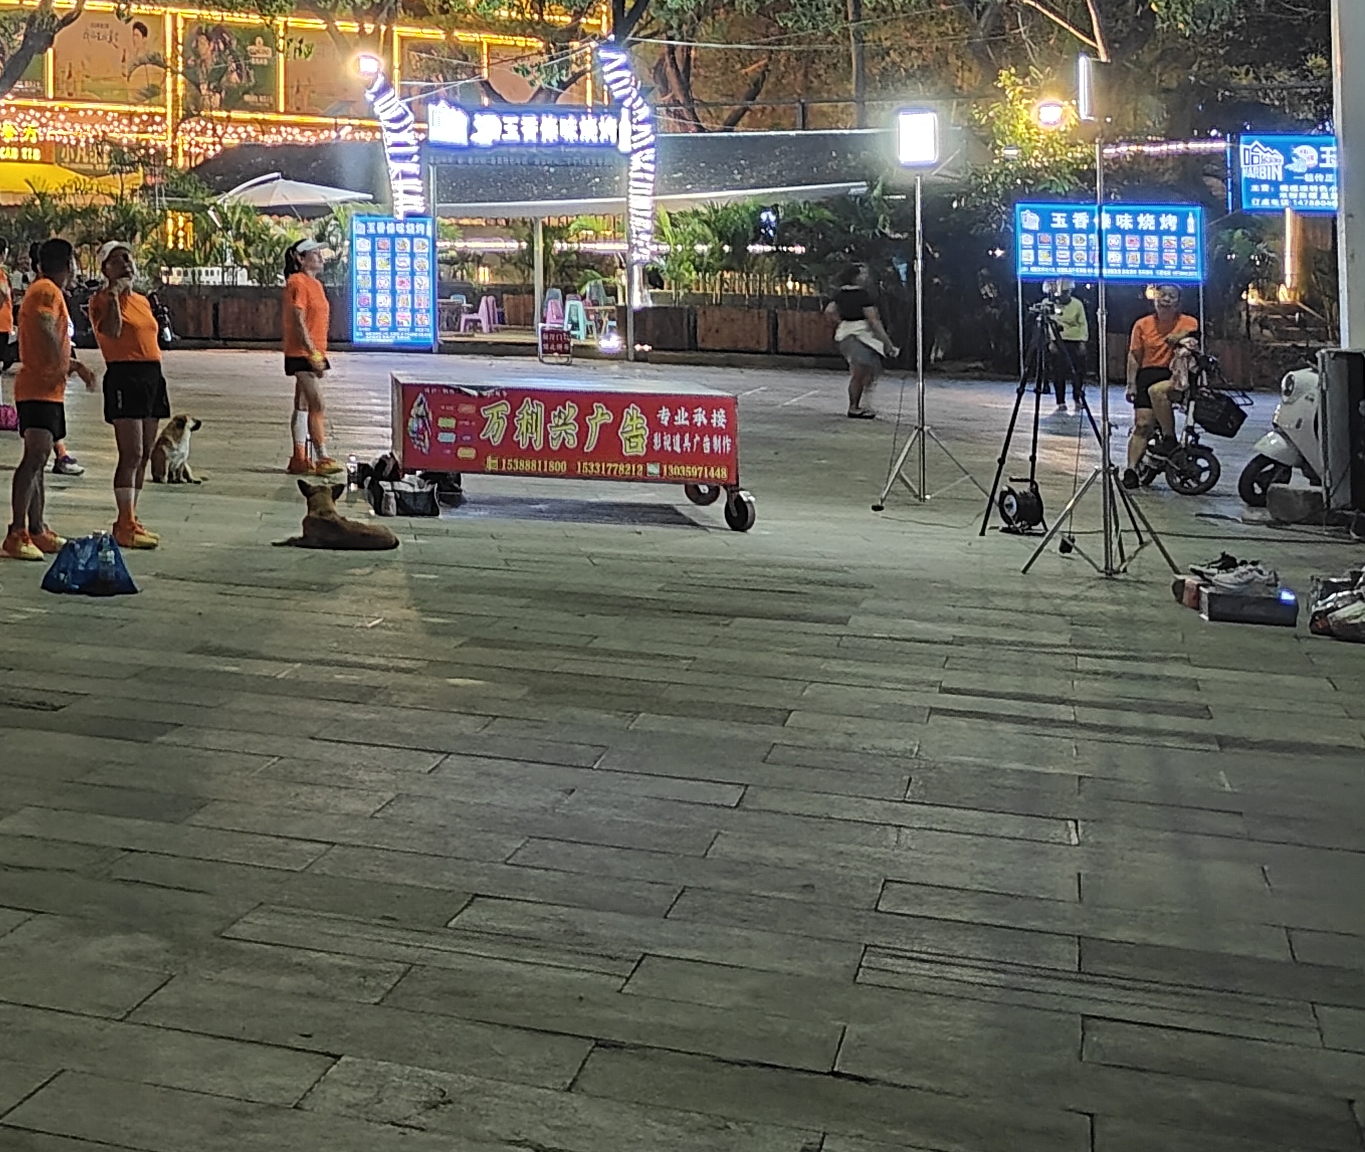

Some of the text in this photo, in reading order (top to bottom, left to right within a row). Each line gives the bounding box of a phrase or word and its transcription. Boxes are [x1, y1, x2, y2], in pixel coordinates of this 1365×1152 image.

[479, 398, 649, 457] 万利兴广告
[656, 405, 728, 429] 专业承接
